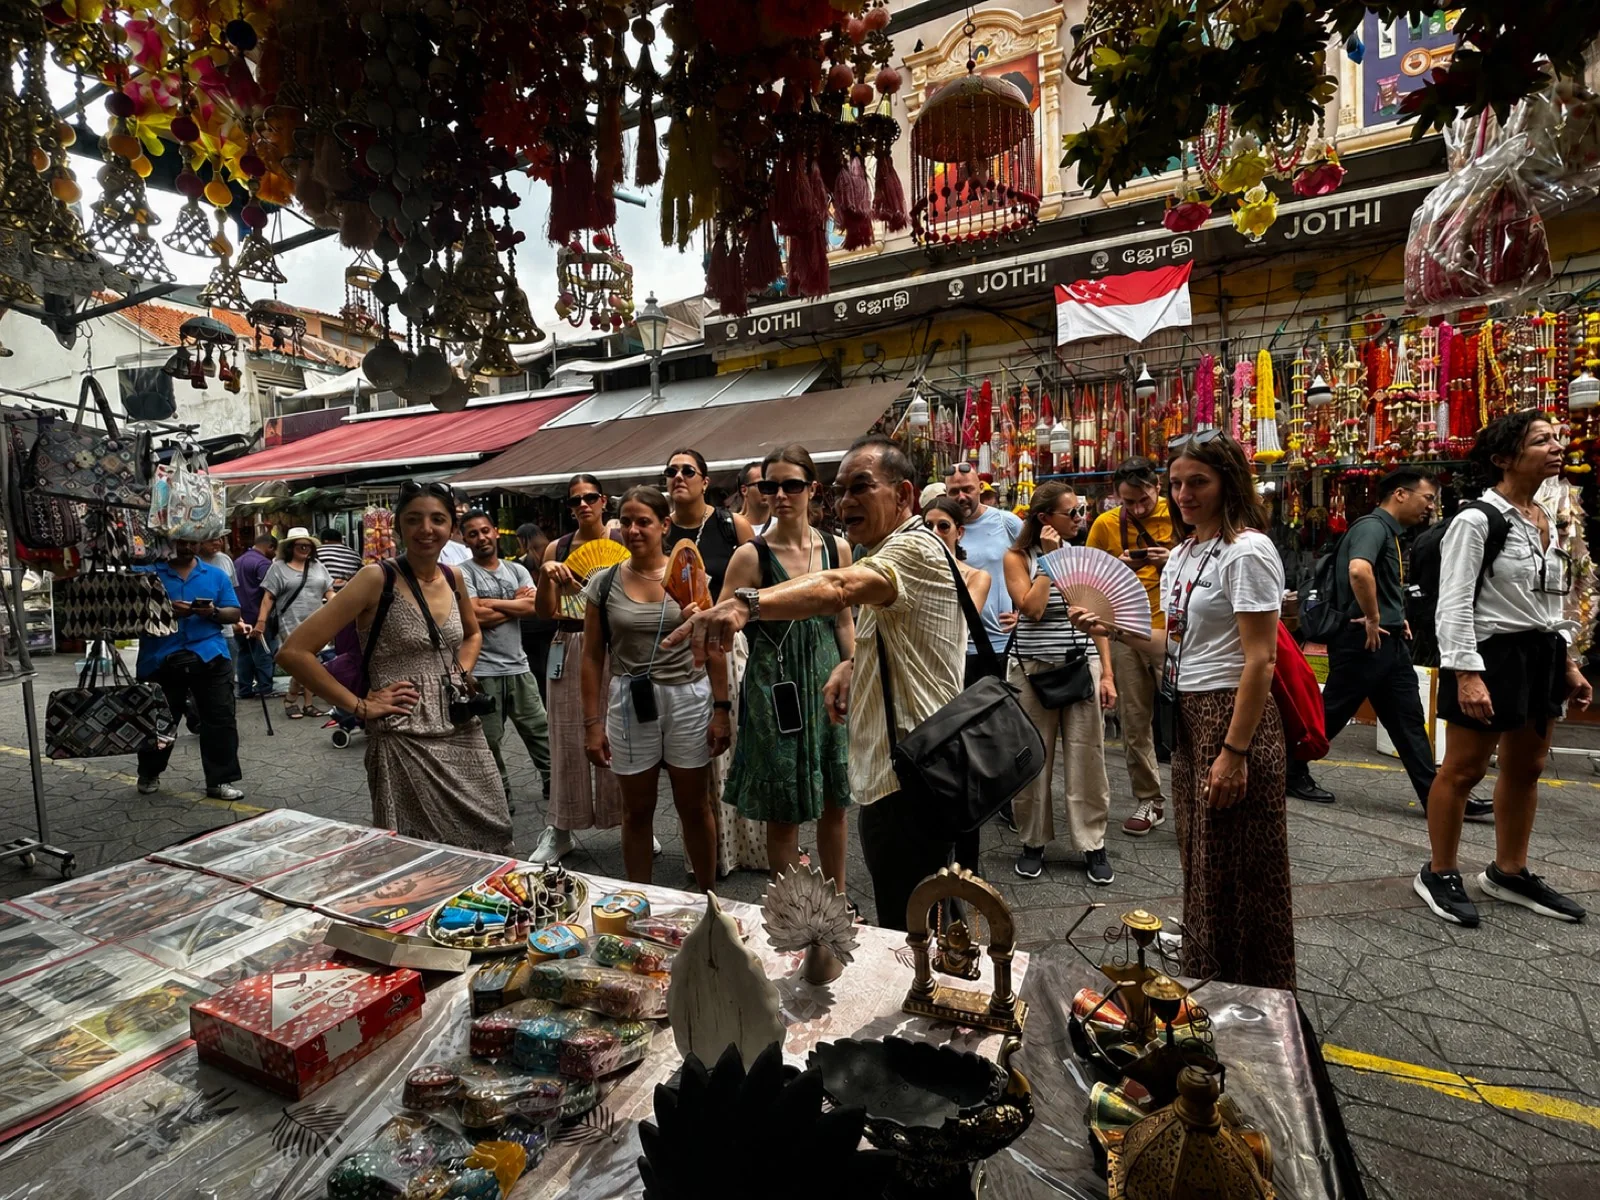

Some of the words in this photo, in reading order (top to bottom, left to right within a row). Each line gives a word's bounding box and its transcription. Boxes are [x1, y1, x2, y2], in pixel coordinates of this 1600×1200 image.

[1284, 200, 1381, 240] JOTHI
[1122, 237, 1193, 265] ஜோதி
[977, 263, 1047, 294] JOTHI
[856, 290, 910, 315] ஜோதி
[747, 311, 801, 336] JOTHI
